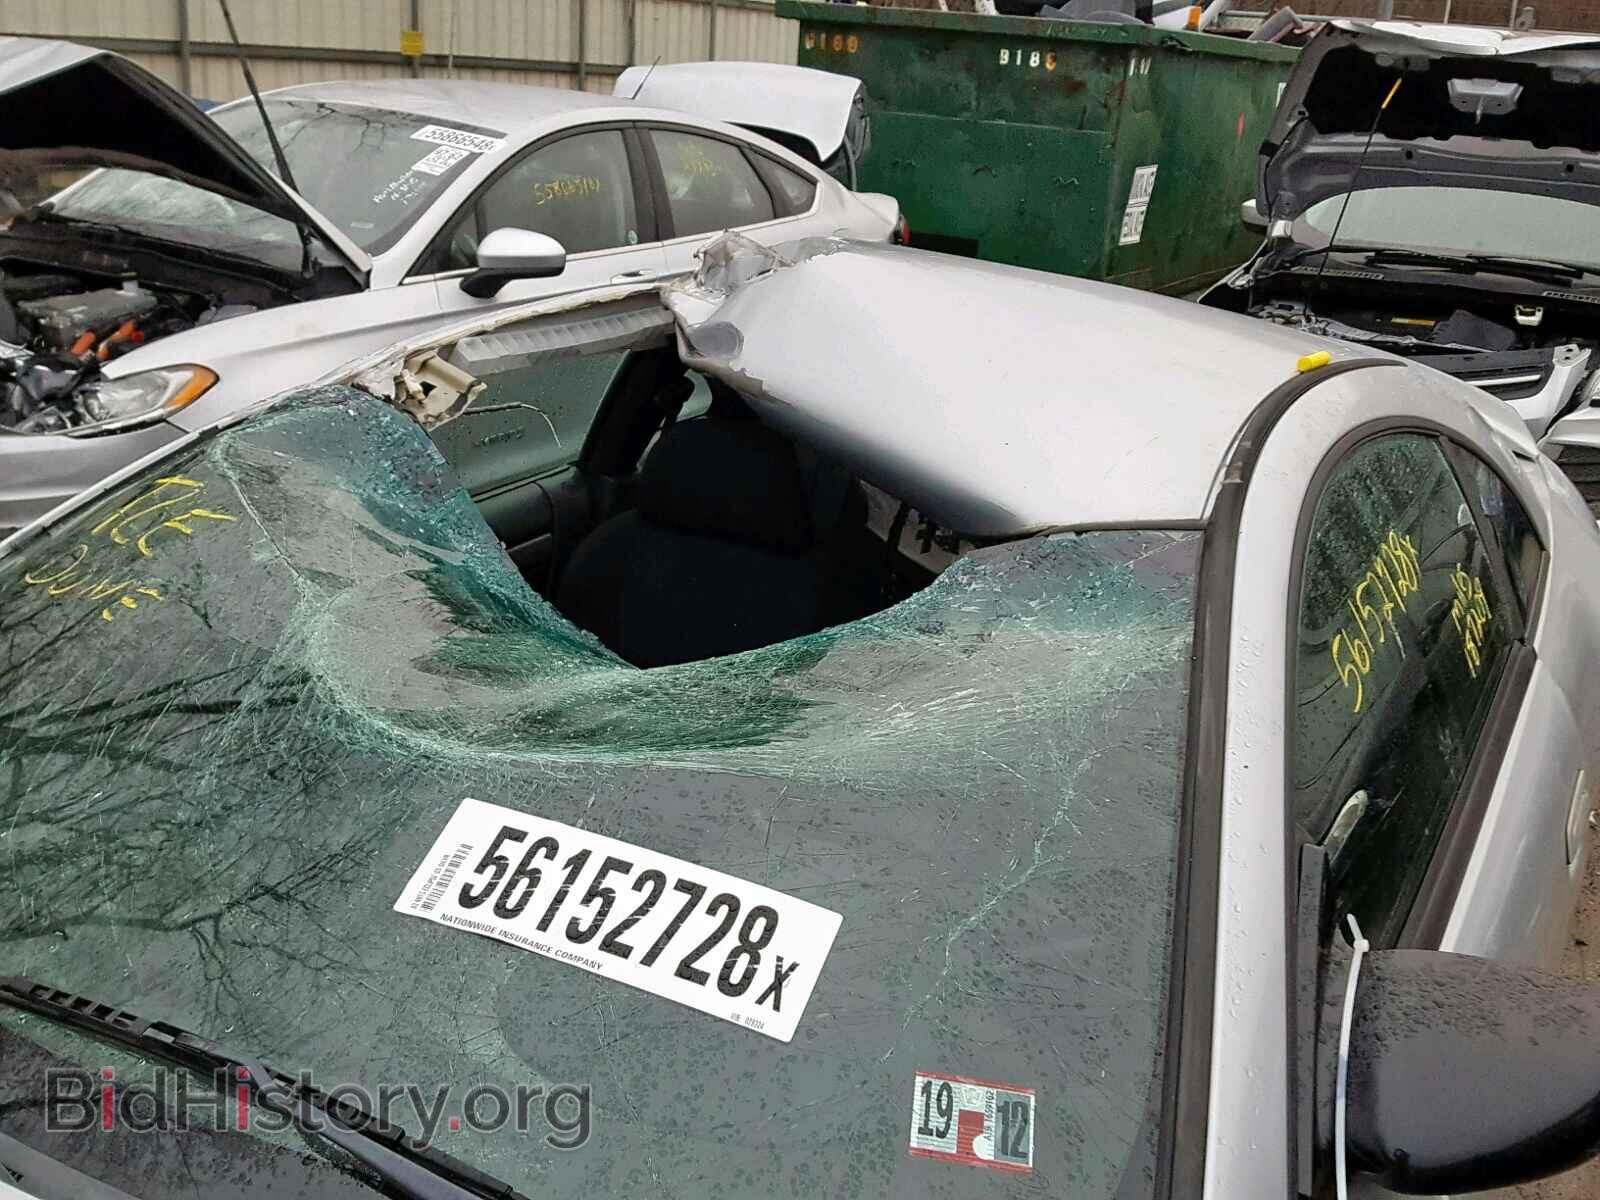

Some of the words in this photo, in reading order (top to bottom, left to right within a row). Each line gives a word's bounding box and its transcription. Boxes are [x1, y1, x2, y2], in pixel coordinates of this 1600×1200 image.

[440, 912, 497, 936] NATIONWIDE
[498, 928, 553, 954] INSURANCE
[554, 948, 603, 971] COMPANY
[918, 1080, 954, 1140] 19
[995, 1101, 1029, 1158] 12
